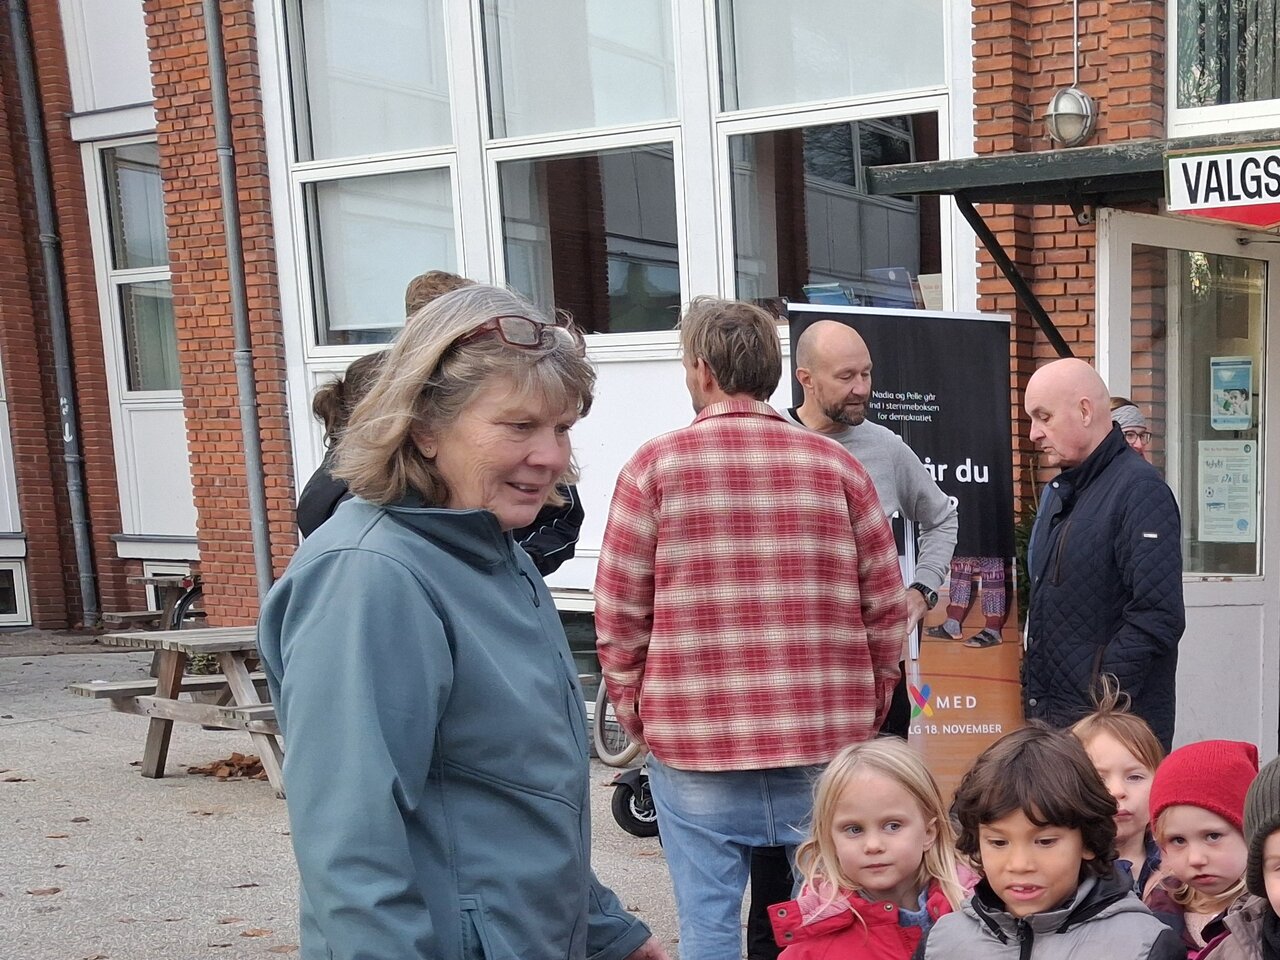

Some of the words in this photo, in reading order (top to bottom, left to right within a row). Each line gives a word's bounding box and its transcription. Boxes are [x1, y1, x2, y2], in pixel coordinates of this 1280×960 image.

[872, 391, 894, 399] Nadia
[895, 393, 906, 401] og
[906, 392, 923, 400] Pelle
[924, 393, 936, 402] går
[886, 403, 940, 411] stemmeboksen
[877, 412, 888, 420] for
[888, 413, 932, 422] demokratiet
[923, 457, 948, 482] år
[955, 458, 989, 483] du
[936, 696, 977, 709] MED
[909, 725, 922, 735] LG
[925, 725, 940, 735] 18.
[943, 724, 1002, 734] NOVEMBER
